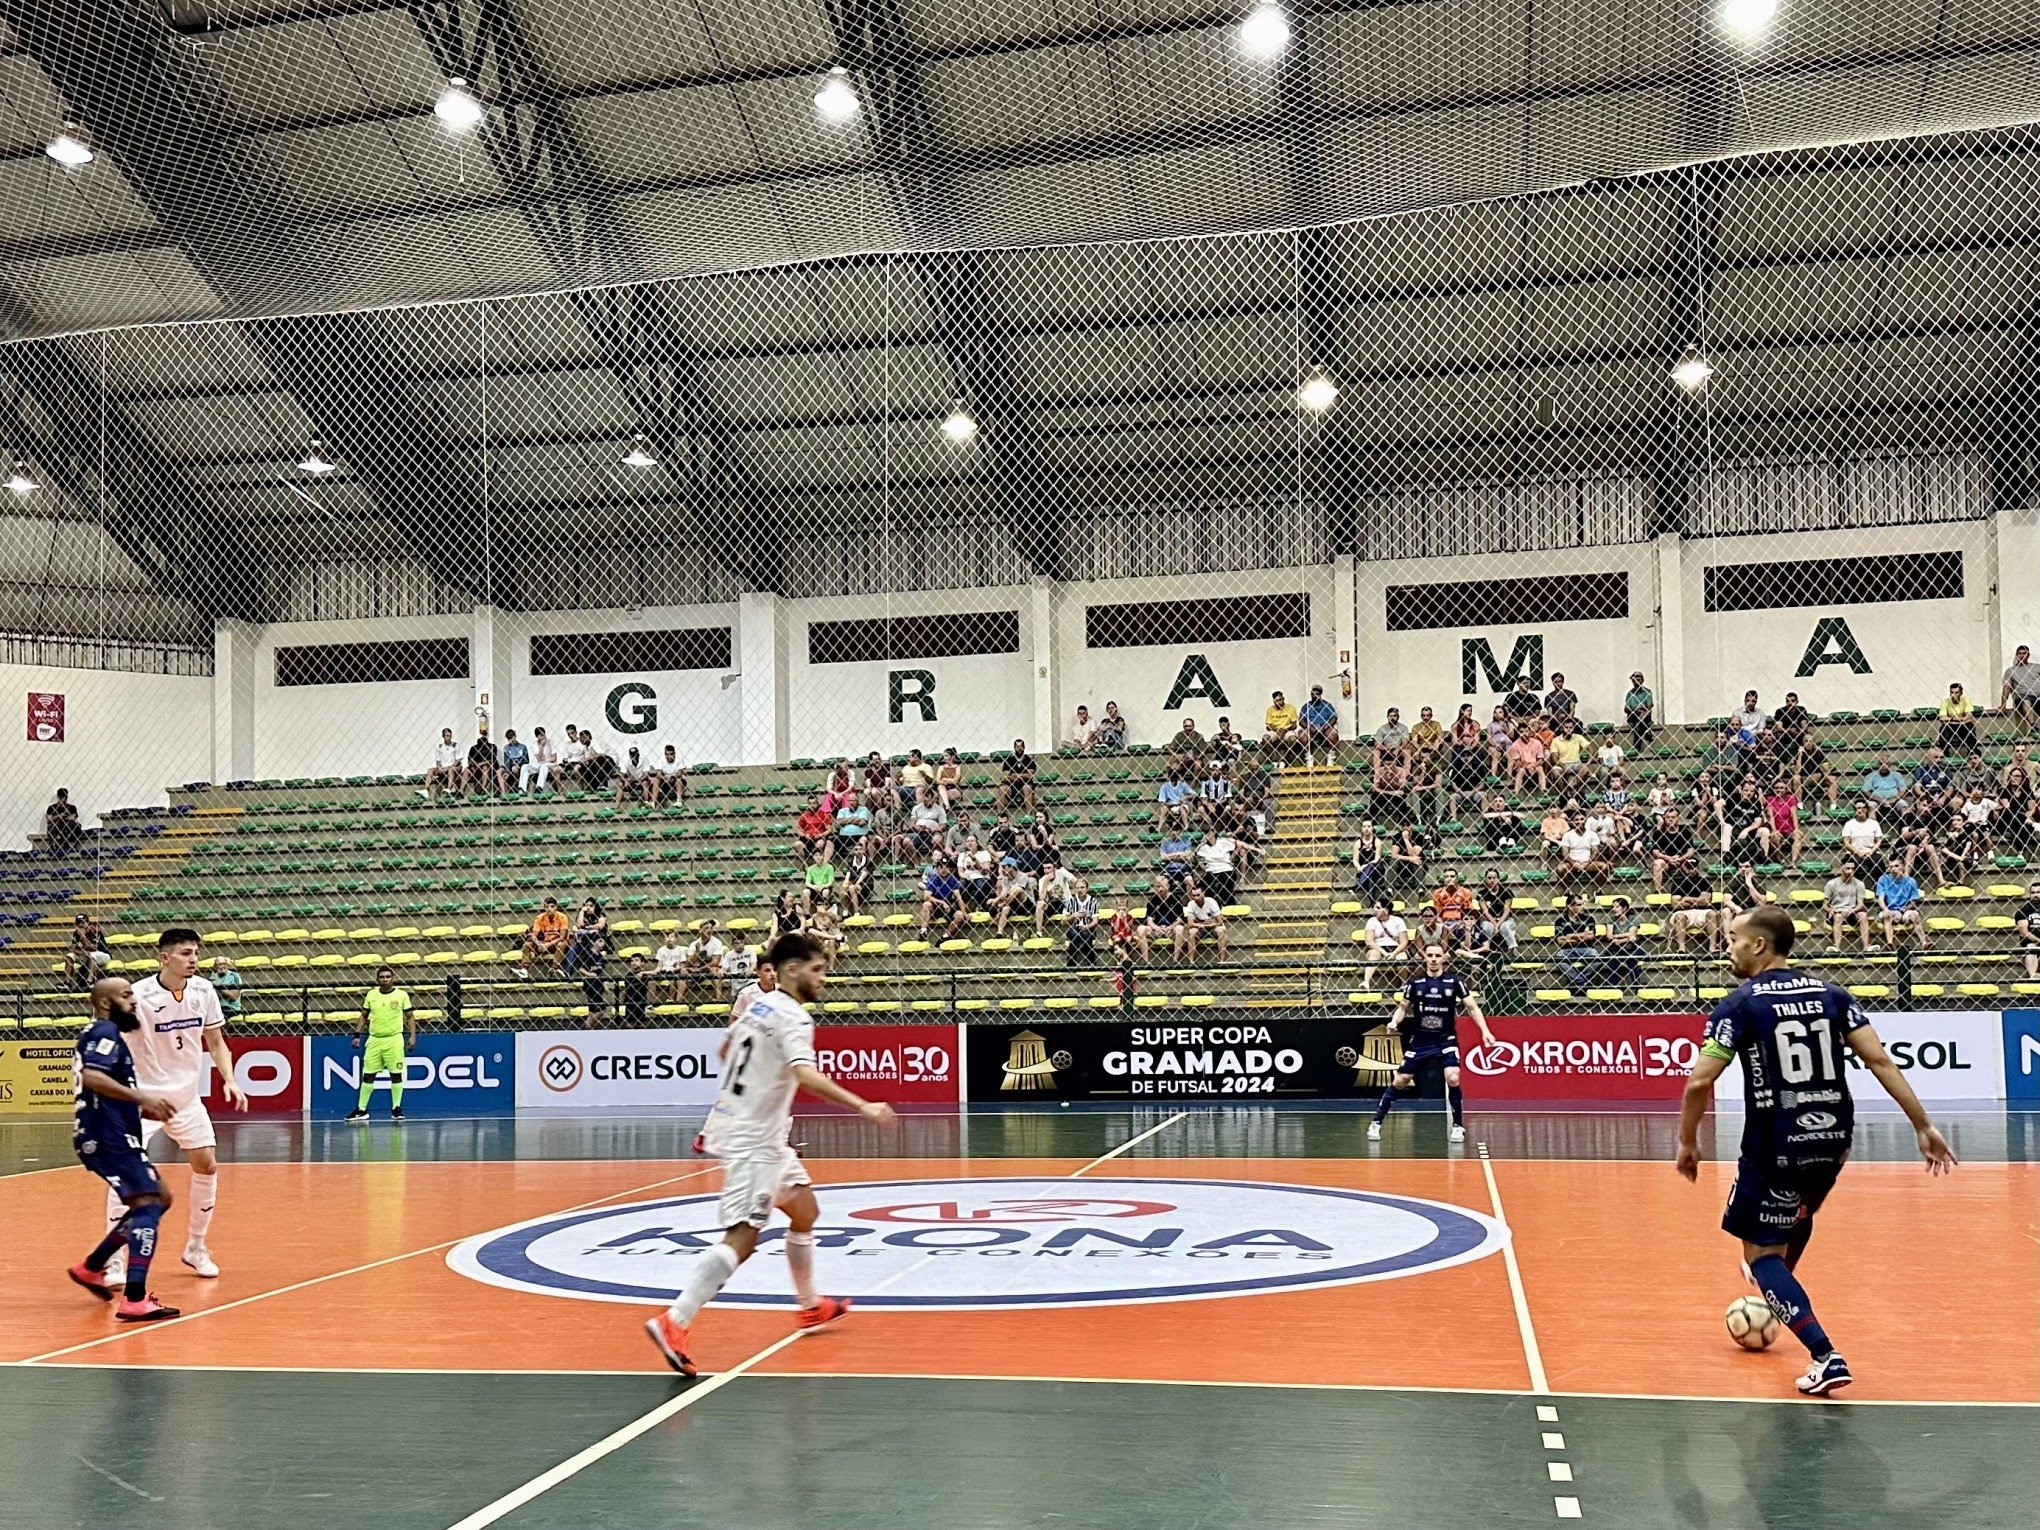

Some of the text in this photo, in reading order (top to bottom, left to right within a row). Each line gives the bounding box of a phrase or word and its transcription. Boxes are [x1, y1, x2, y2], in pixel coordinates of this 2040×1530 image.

[604, 617, 1873, 735] G R A M A
[1752, 976, 1824, 992] SafraMax
[1772, 1000, 1824, 1017] THALES
[159, 1020, 200, 1031] TRAMONTINA
[176, 1036, 183, 1050] 3
[1131, 1026, 1272, 1045] SUPER COPA
[53, 1049, 73, 1057] OFICI
[1523, 1041, 1637, 1066] KRONA
[1645, 1037, 1699, 1077] 30
[1774, 1018, 1836, 1084] 61
[590, 1054, 718, 1080] CRESOL
[816, 1049, 897, 1072] RONA
[903, 1046, 950, 1082] 30
[1102, 1048, 1304, 1076] GRAMADO
[1523, 1063, 1638, 1074] TUBOS E CONEXÕES
[1748, 1042, 1764, 1087] COPEL
[836, 1072, 842, 1080] E
[846, 1070, 898, 1080] CONEXÕES
[921, 1074, 949, 1082] anos
[1666, 1068, 1693, 1077] ano
[1131, 1076, 1275, 1094] DE FUTSAL 2024
[1787, 1130, 1846, 1142] NORDESTE
[597, 1226, 1334, 1251] KRONA
[926, 1248, 1333, 1260] CONEXÕES
[1765, 1289, 1792, 1324] coamo
